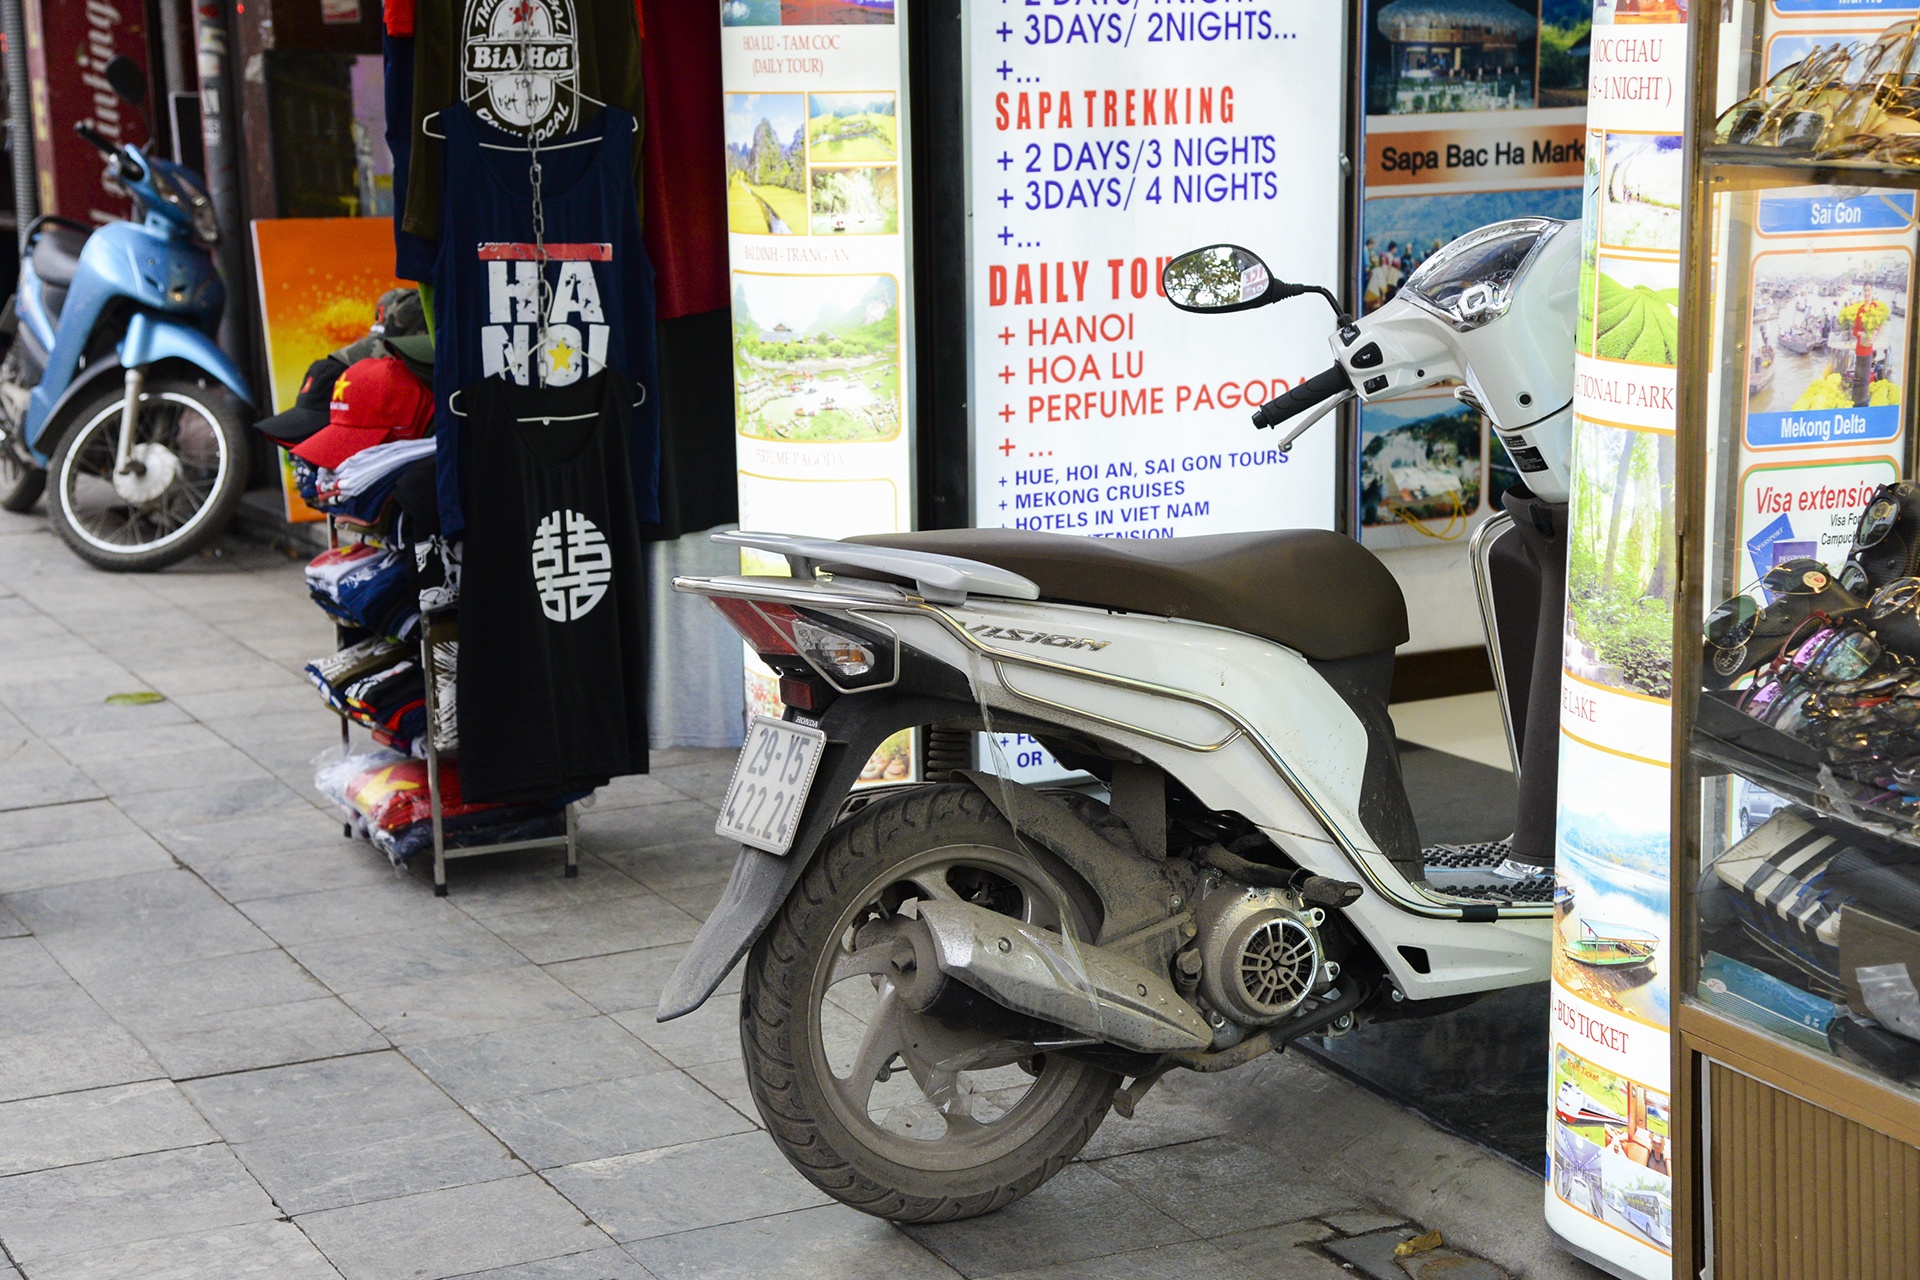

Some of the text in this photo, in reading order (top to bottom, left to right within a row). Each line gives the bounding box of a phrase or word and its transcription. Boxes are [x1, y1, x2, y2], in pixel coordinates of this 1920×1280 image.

[783, 35, 809, 50] TAM
[812, 35, 840, 50] COC
[1024, 12, 1137, 48] 3DAYS/
[1148, 10, 1296, 42] 2NIGHTS...
[752, 58, 824, 76] (DAILY TOUR)
[1615, 39, 1663, 62] CHAU
[1612, 76, 1663, 100] NIGHT
[995, 86, 1234, 131] SAPA TREKKING
[1025, 143, 1042, 173] 2
[1174, 134, 1277, 168] NIGHTS
[1381, 138, 1586, 176] Sapa Bac Ha Mark
[1024, 177, 1136, 211] 3DAYS/
[1145, 176, 1162, 205] 4
[1173, 171, 1278, 204] NIGHTS
[1811, 202, 1861, 225] Sai Gon
[786, 247, 827, 262] TRANG
[832, 248, 850, 261] AN
[488, 261, 605, 323] HA
[988, 260, 1089, 307] DAILY
[1028, 313, 1135, 346] HANOI
[1028, 353, 1101, 385] HOA
[1112, 350, 1144, 380] LU
[1028, 387, 1164, 423] PERFUME
[1176, 377, 1307, 412] PAGOD
[1575, 373, 1674, 410] ATIONAL PARK
[1781, 414, 1866, 441] Mekong Delta
[1015, 468, 1059, 486] HUE,
[1066, 462, 1099, 481] HOI
[1105, 460, 1138, 479] AN,
[1145, 457, 1176, 475] SAI
[1182, 454, 1222, 473] GON
[1228, 449, 1289, 468] TOURS
[1015, 487, 1100, 510] MEKONG
[1106, 480, 1185, 501] CRUISES
[1757, 487, 1792, 514] Visa
[1798, 481, 1874, 511] extensio
[1015, 501, 1210, 532] HOTELS IN VIET NAM
[1830, 513, 1846, 527] Visa
[795, 716, 819, 728] HONDA
[1568, 692, 1597, 722] LAKE
[747, 727, 811, 785] 29-Y5
[1017, 751, 1042, 768] OR
[726, 780, 795, 843] 422.24
[1557, 999, 1576, 1030] BUS
[1578, 1012, 1629, 1054] TICKET
